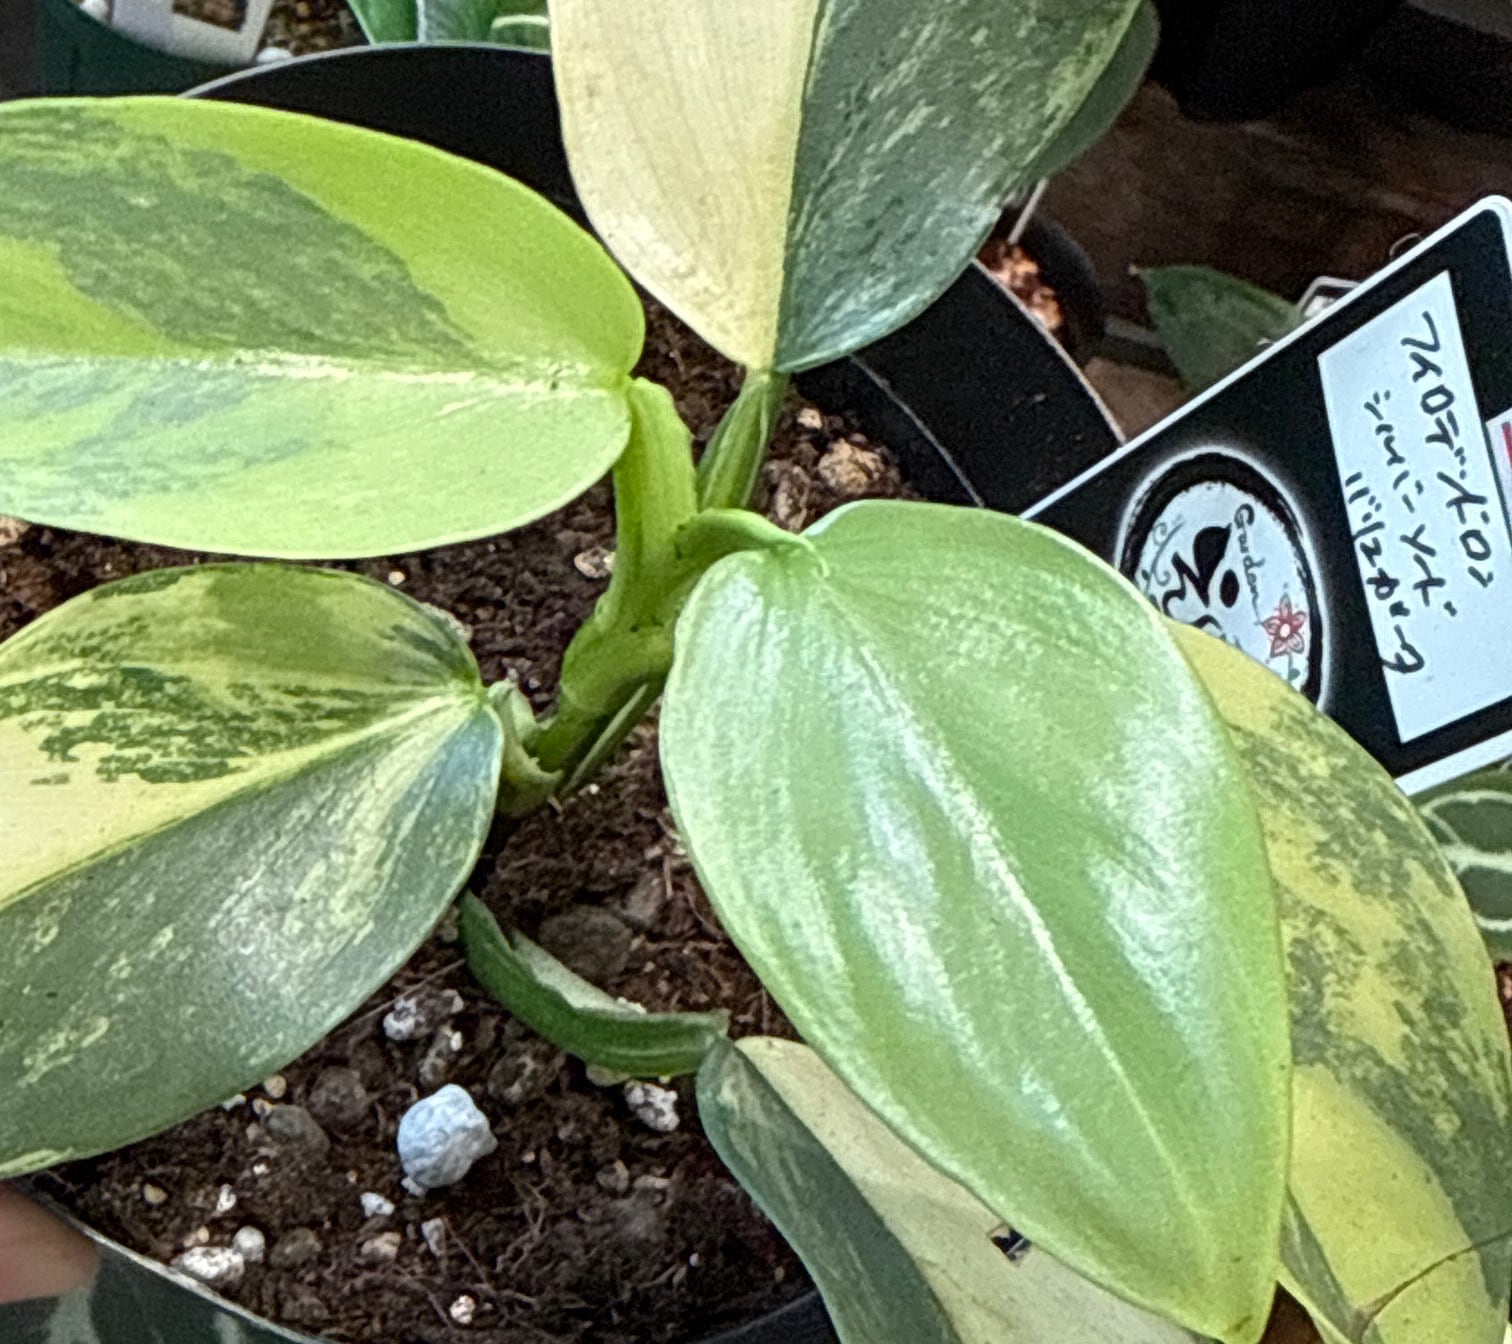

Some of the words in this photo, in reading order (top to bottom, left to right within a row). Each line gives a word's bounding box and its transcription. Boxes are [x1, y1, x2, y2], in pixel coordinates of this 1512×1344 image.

[1401, 311, 1494, 589] フィロデンドロン
